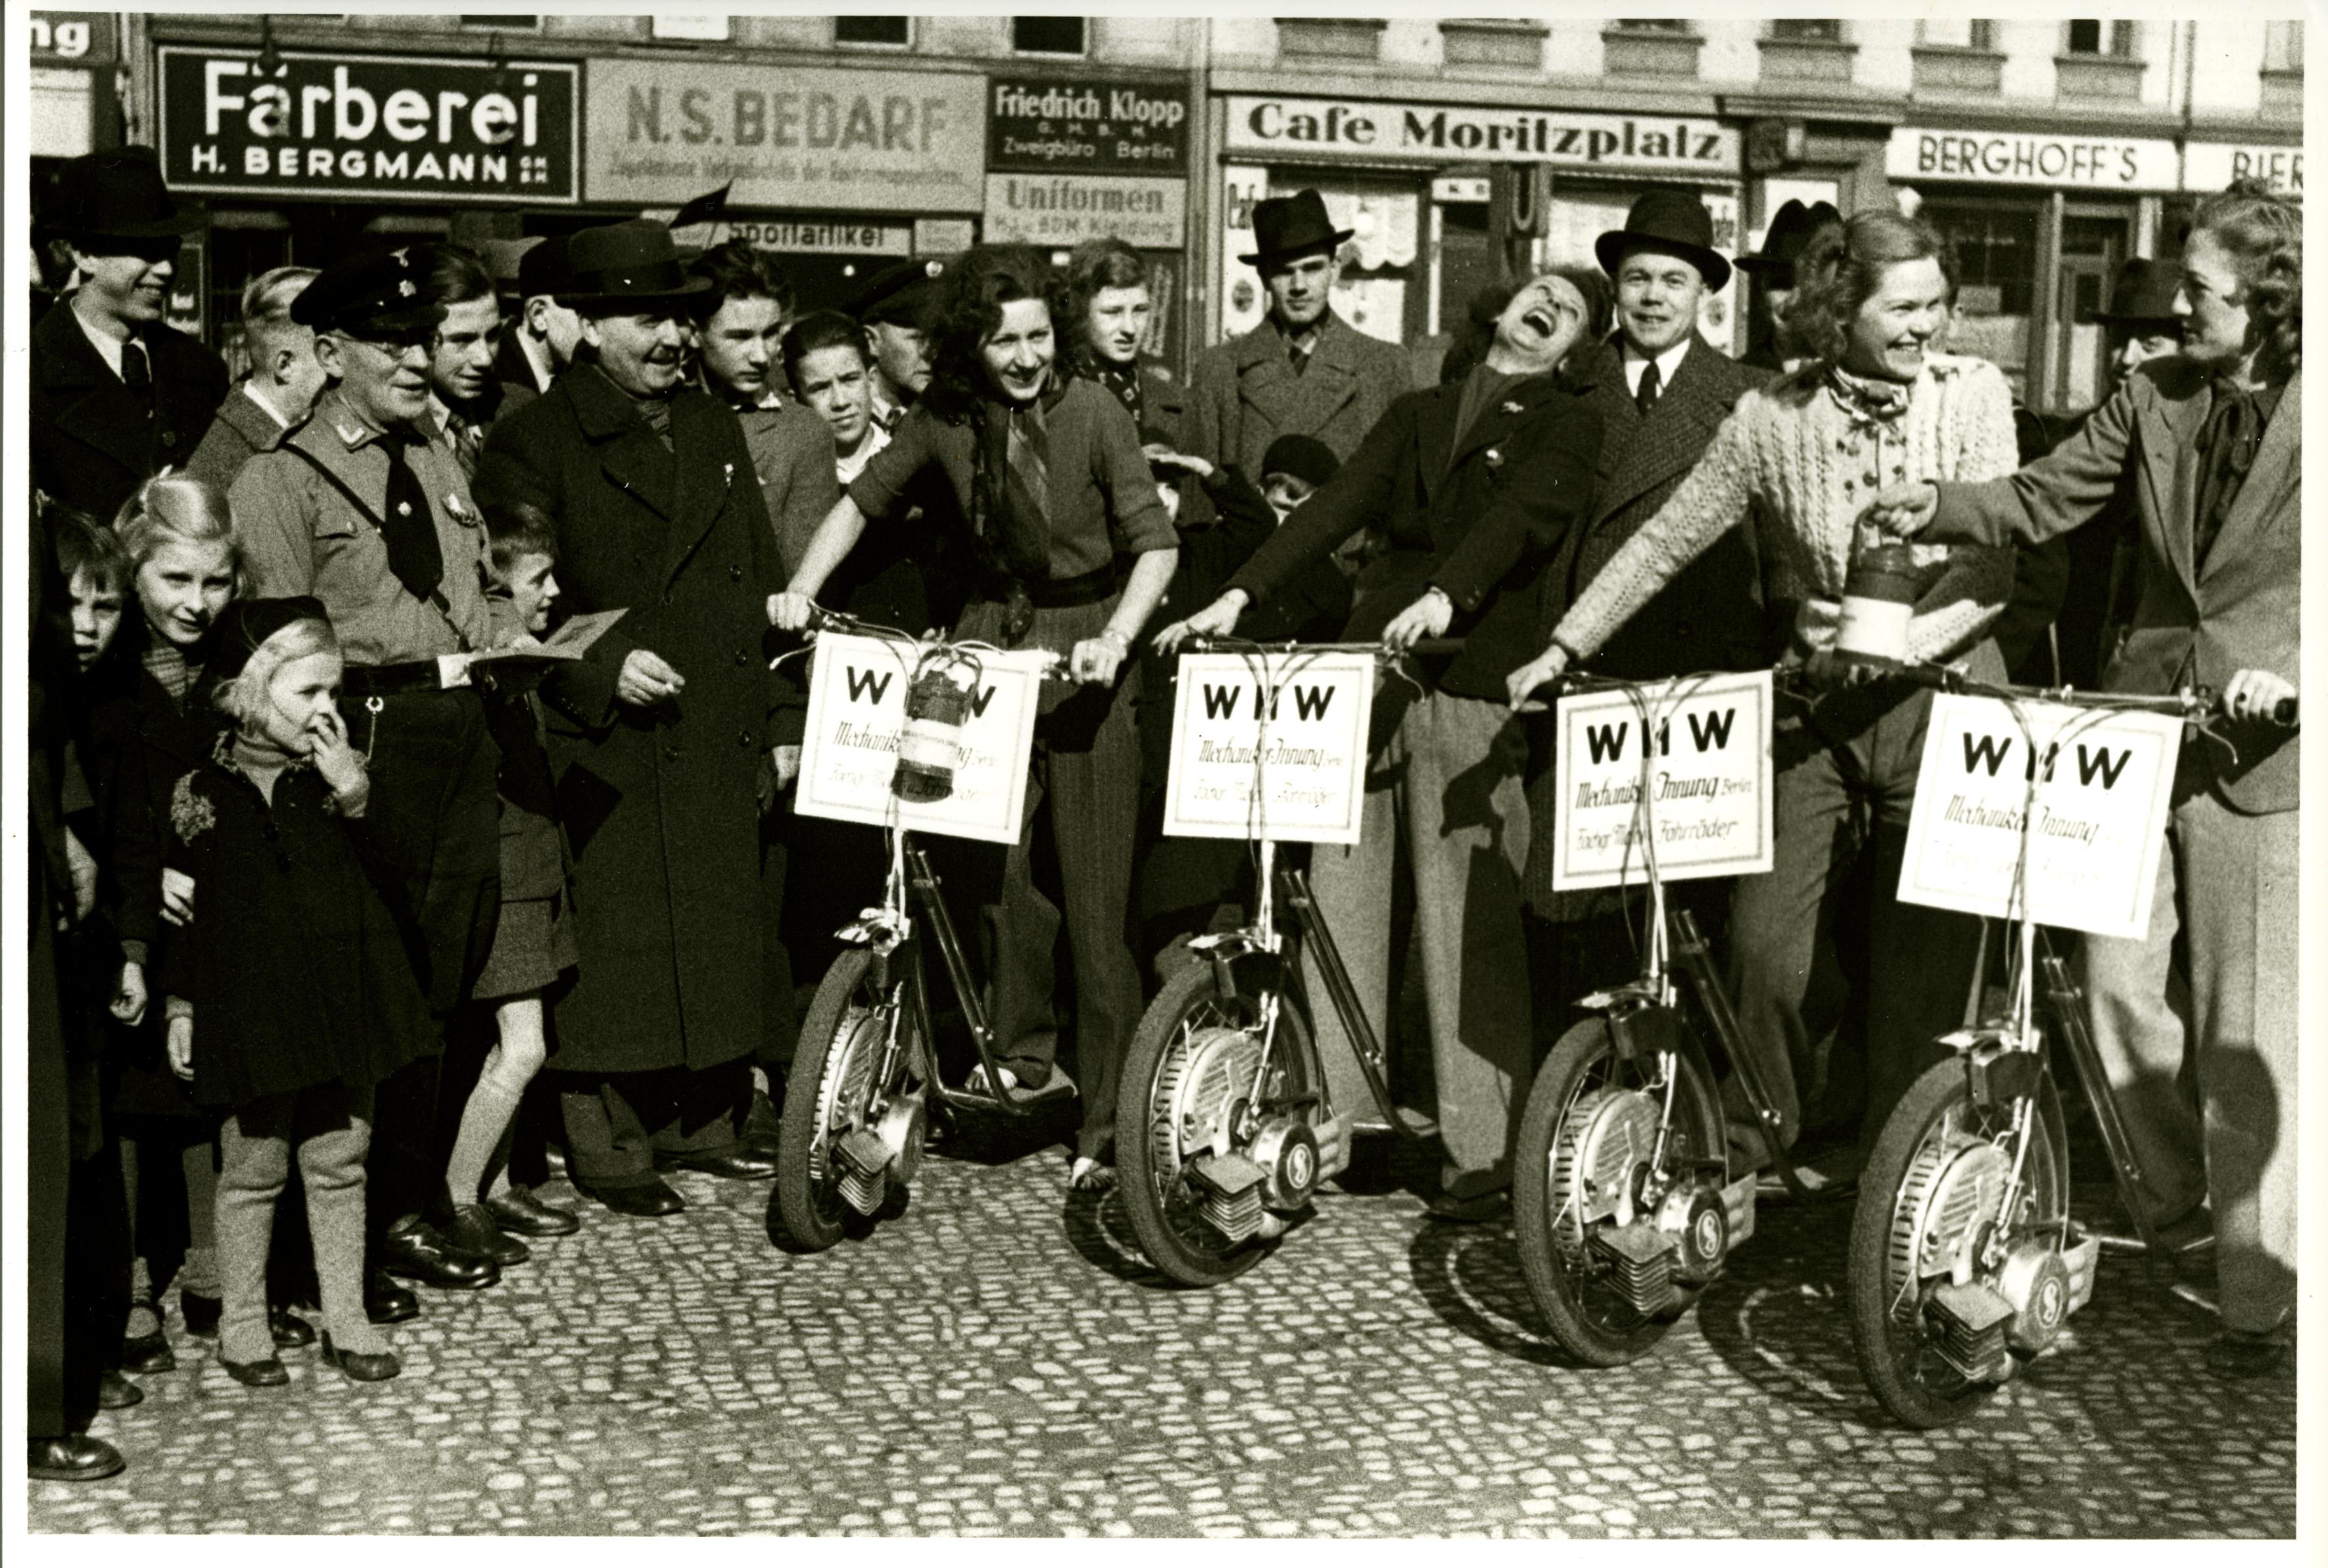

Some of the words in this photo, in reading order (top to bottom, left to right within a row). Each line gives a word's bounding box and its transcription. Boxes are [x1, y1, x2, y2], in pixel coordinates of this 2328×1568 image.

[205, 60, 537, 147] Färberei
[996, 85, 1100, 119] Friedrich
[1110, 90, 1183, 128] Klopp
[1117, 140, 1175, 158] Berlin
[1404, 109, 1722, 163] Moritzplatz
[192, 144, 226, 173] H.
[245, 145, 506, 182] BERGMANN
[1917, 135, 2138, 182] BERGHOFF'S
[1007, 179, 1164, 214] Uniformen
